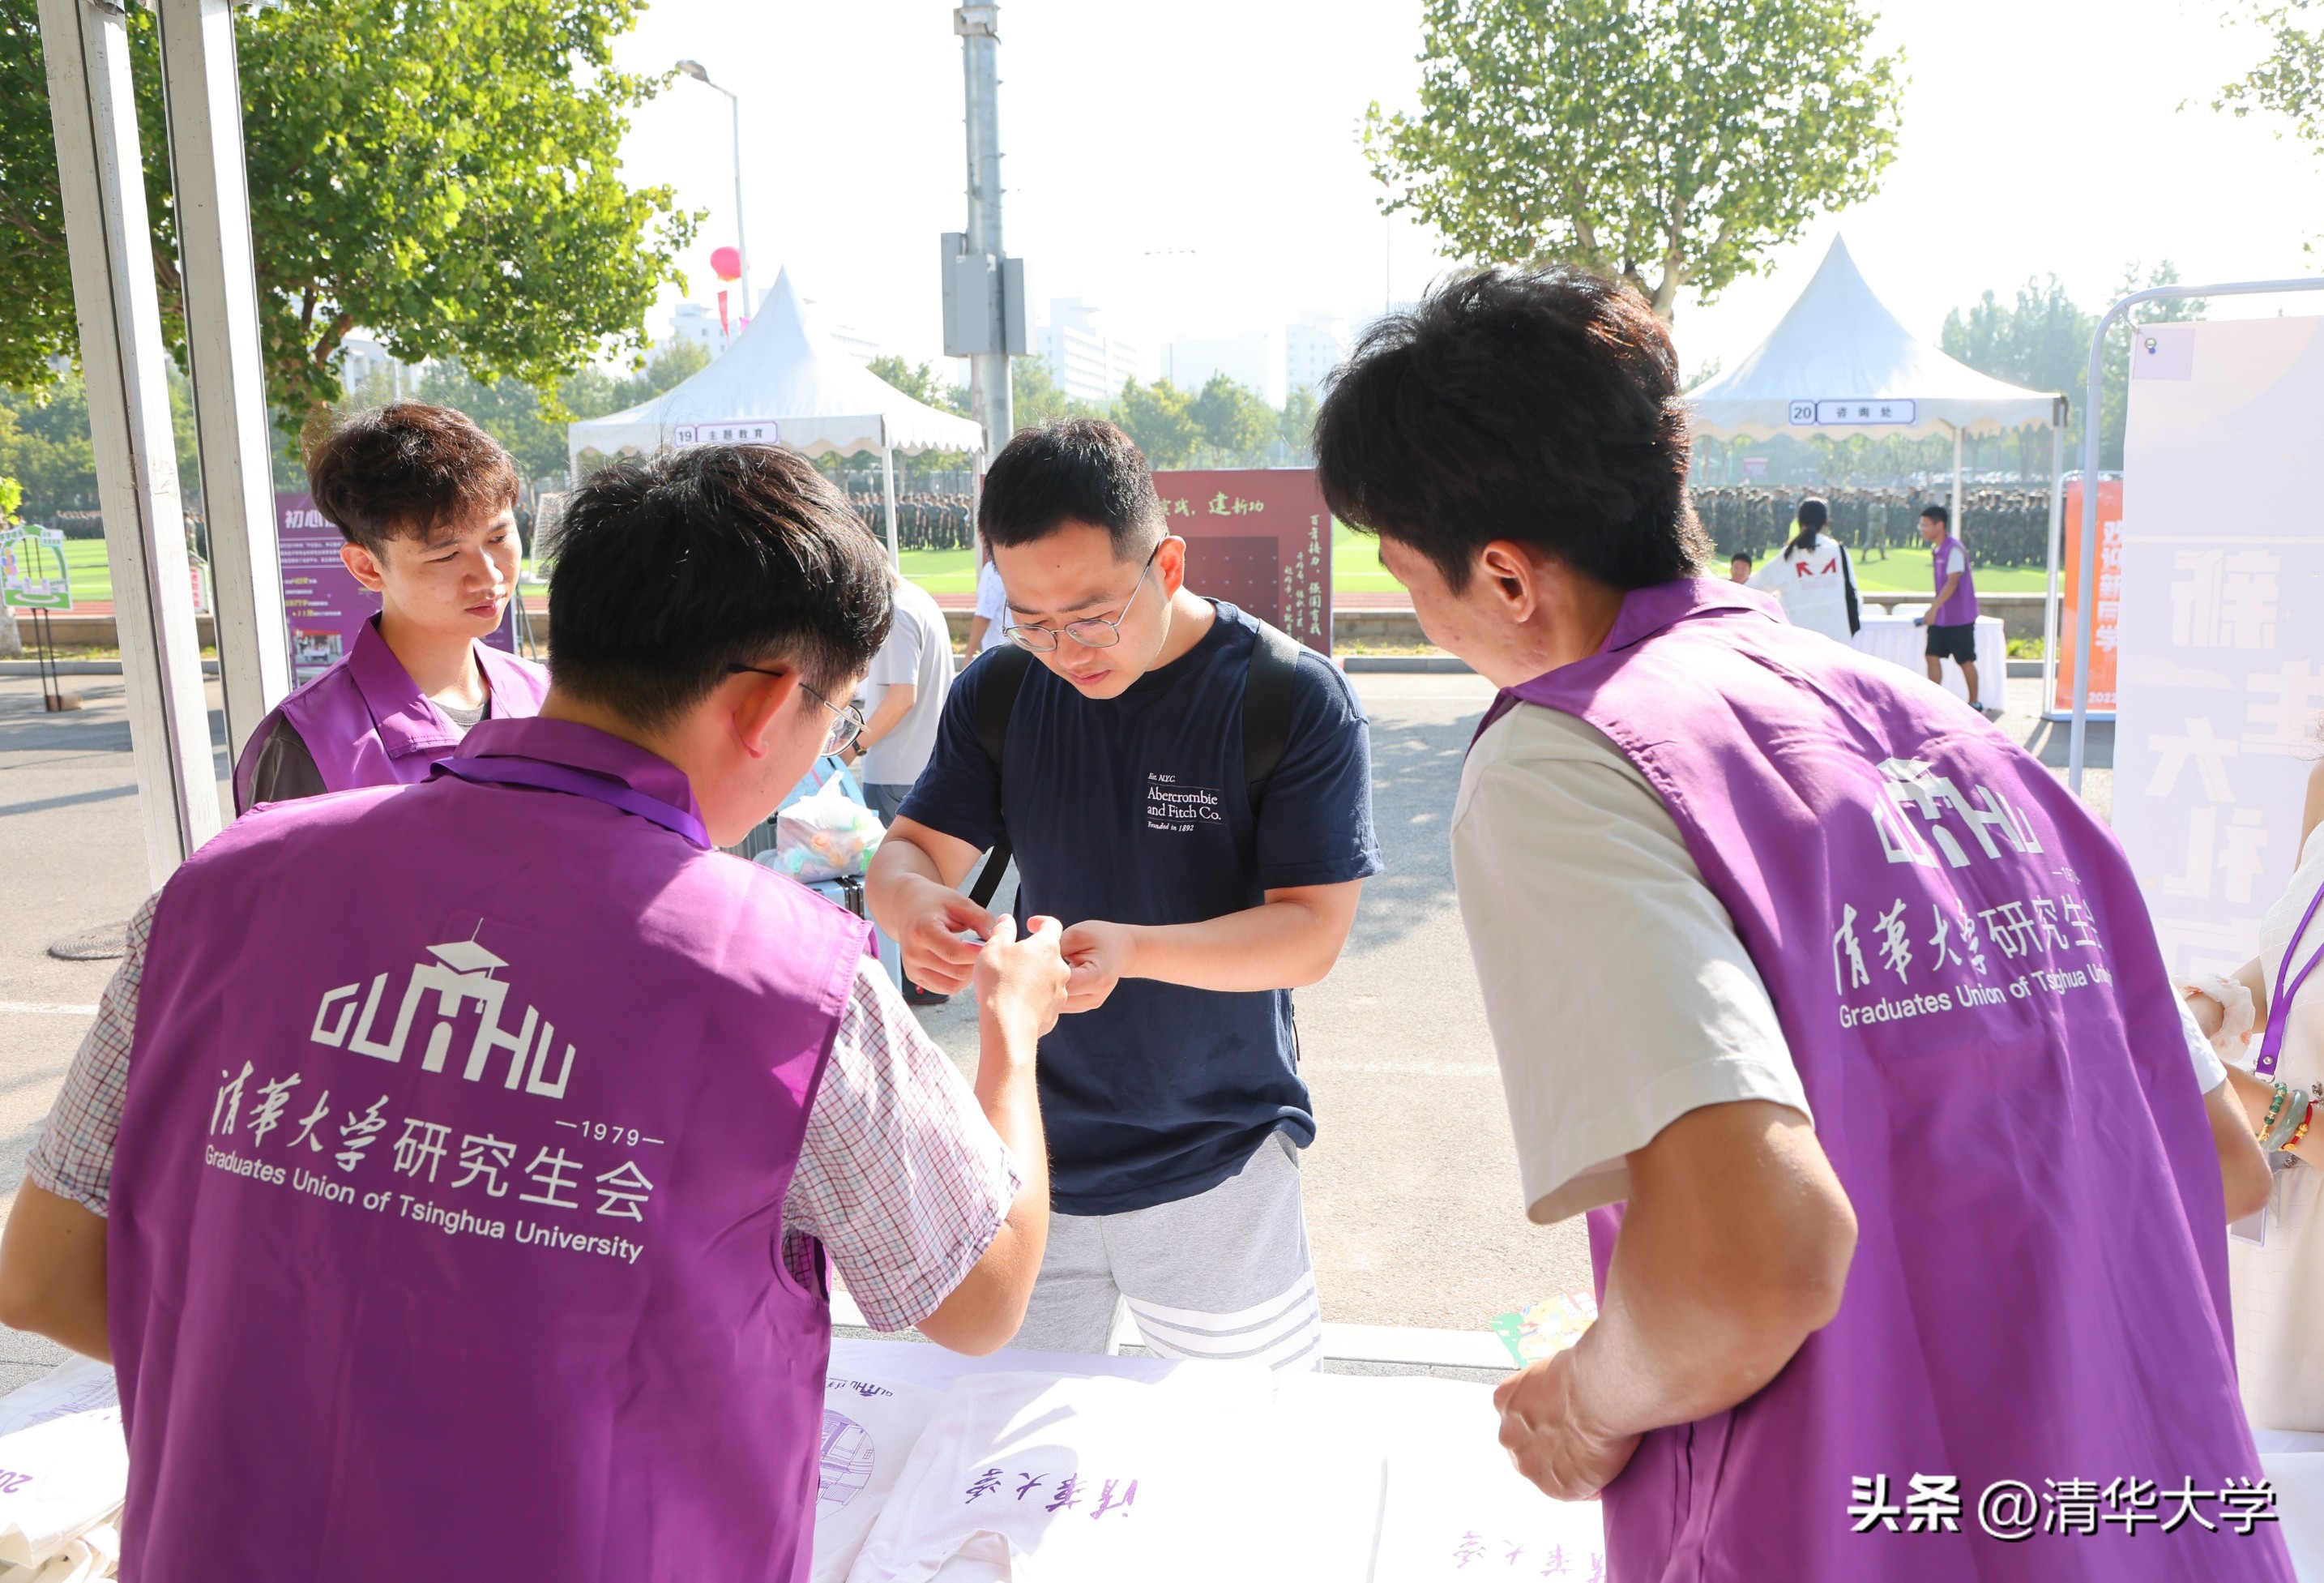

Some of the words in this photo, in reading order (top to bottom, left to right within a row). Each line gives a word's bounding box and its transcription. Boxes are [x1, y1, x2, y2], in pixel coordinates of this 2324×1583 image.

[1793, 407, 1812, 419] 20
[1836, 407, 1891, 418] 咨询处
[677, 430, 693, 442] 19
[708, 428, 763, 440] 主题教育
[1147, 787, 1219, 805] Abercrombie
[1147, 803, 1166, 817] and
[1168, 804, 1197, 819] Fitch
[1199, 806, 1222, 820] Co.
[1147, 821, 1169, 830] Founded
[1178, 824, 1194, 832] 1892
[1839, 991, 1952, 1029] Graduates
[1958, 982, 2007, 1010] Union
[2010, 978, 2031, 1000] of
[205, 1144, 286, 1186] Graduates
[292, 1166, 355, 1206] Union
[362, 1191, 391, 1213] of
[399, 1195, 506, 1240] Tsinghua
[515, 1220, 643, 1264] University
